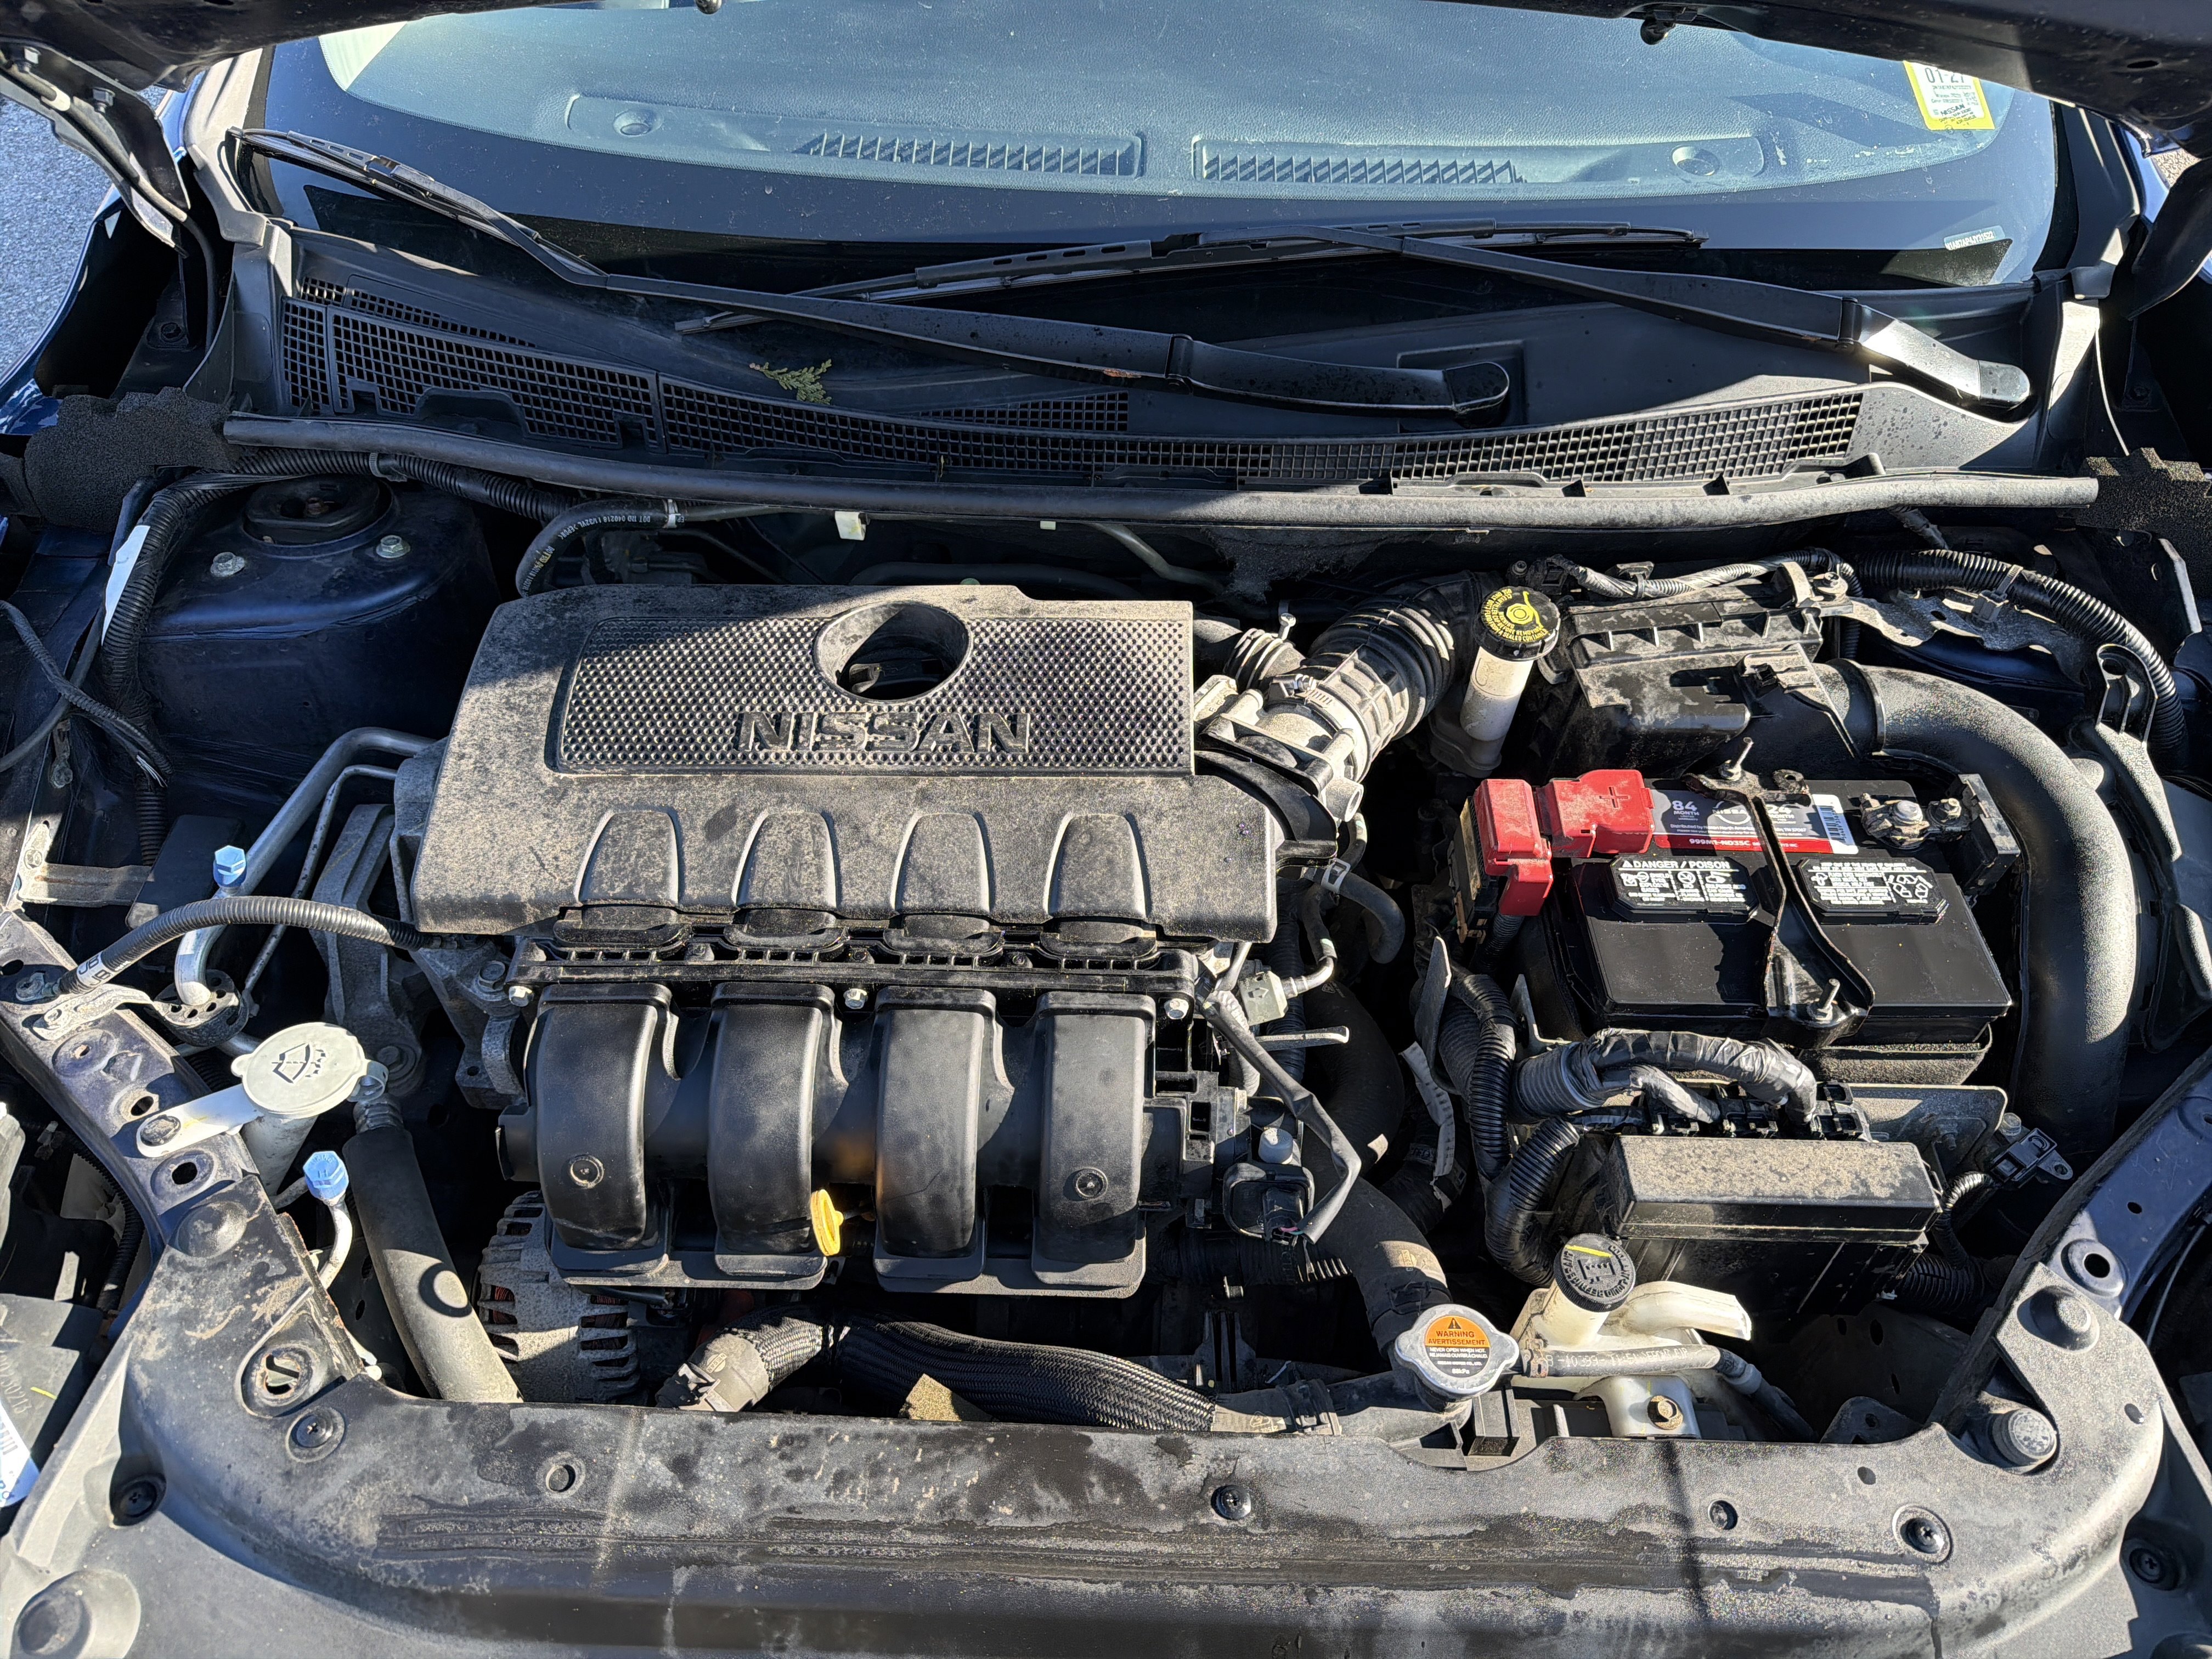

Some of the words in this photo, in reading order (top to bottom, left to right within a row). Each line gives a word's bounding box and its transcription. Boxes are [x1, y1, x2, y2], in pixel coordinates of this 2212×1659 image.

[1497, 622, 1515, 635] BEFORE
[1503, 631, 1522, 641] SEALED
[735, 712, 1030, 752] NISSAN
[1672, 800, 1697, 811] 84
[1632, 860, 1679, 868] DANGER
[1688, 861, 1730, 869] POISON
[707, 1353, 726, 1372] NISSAN
